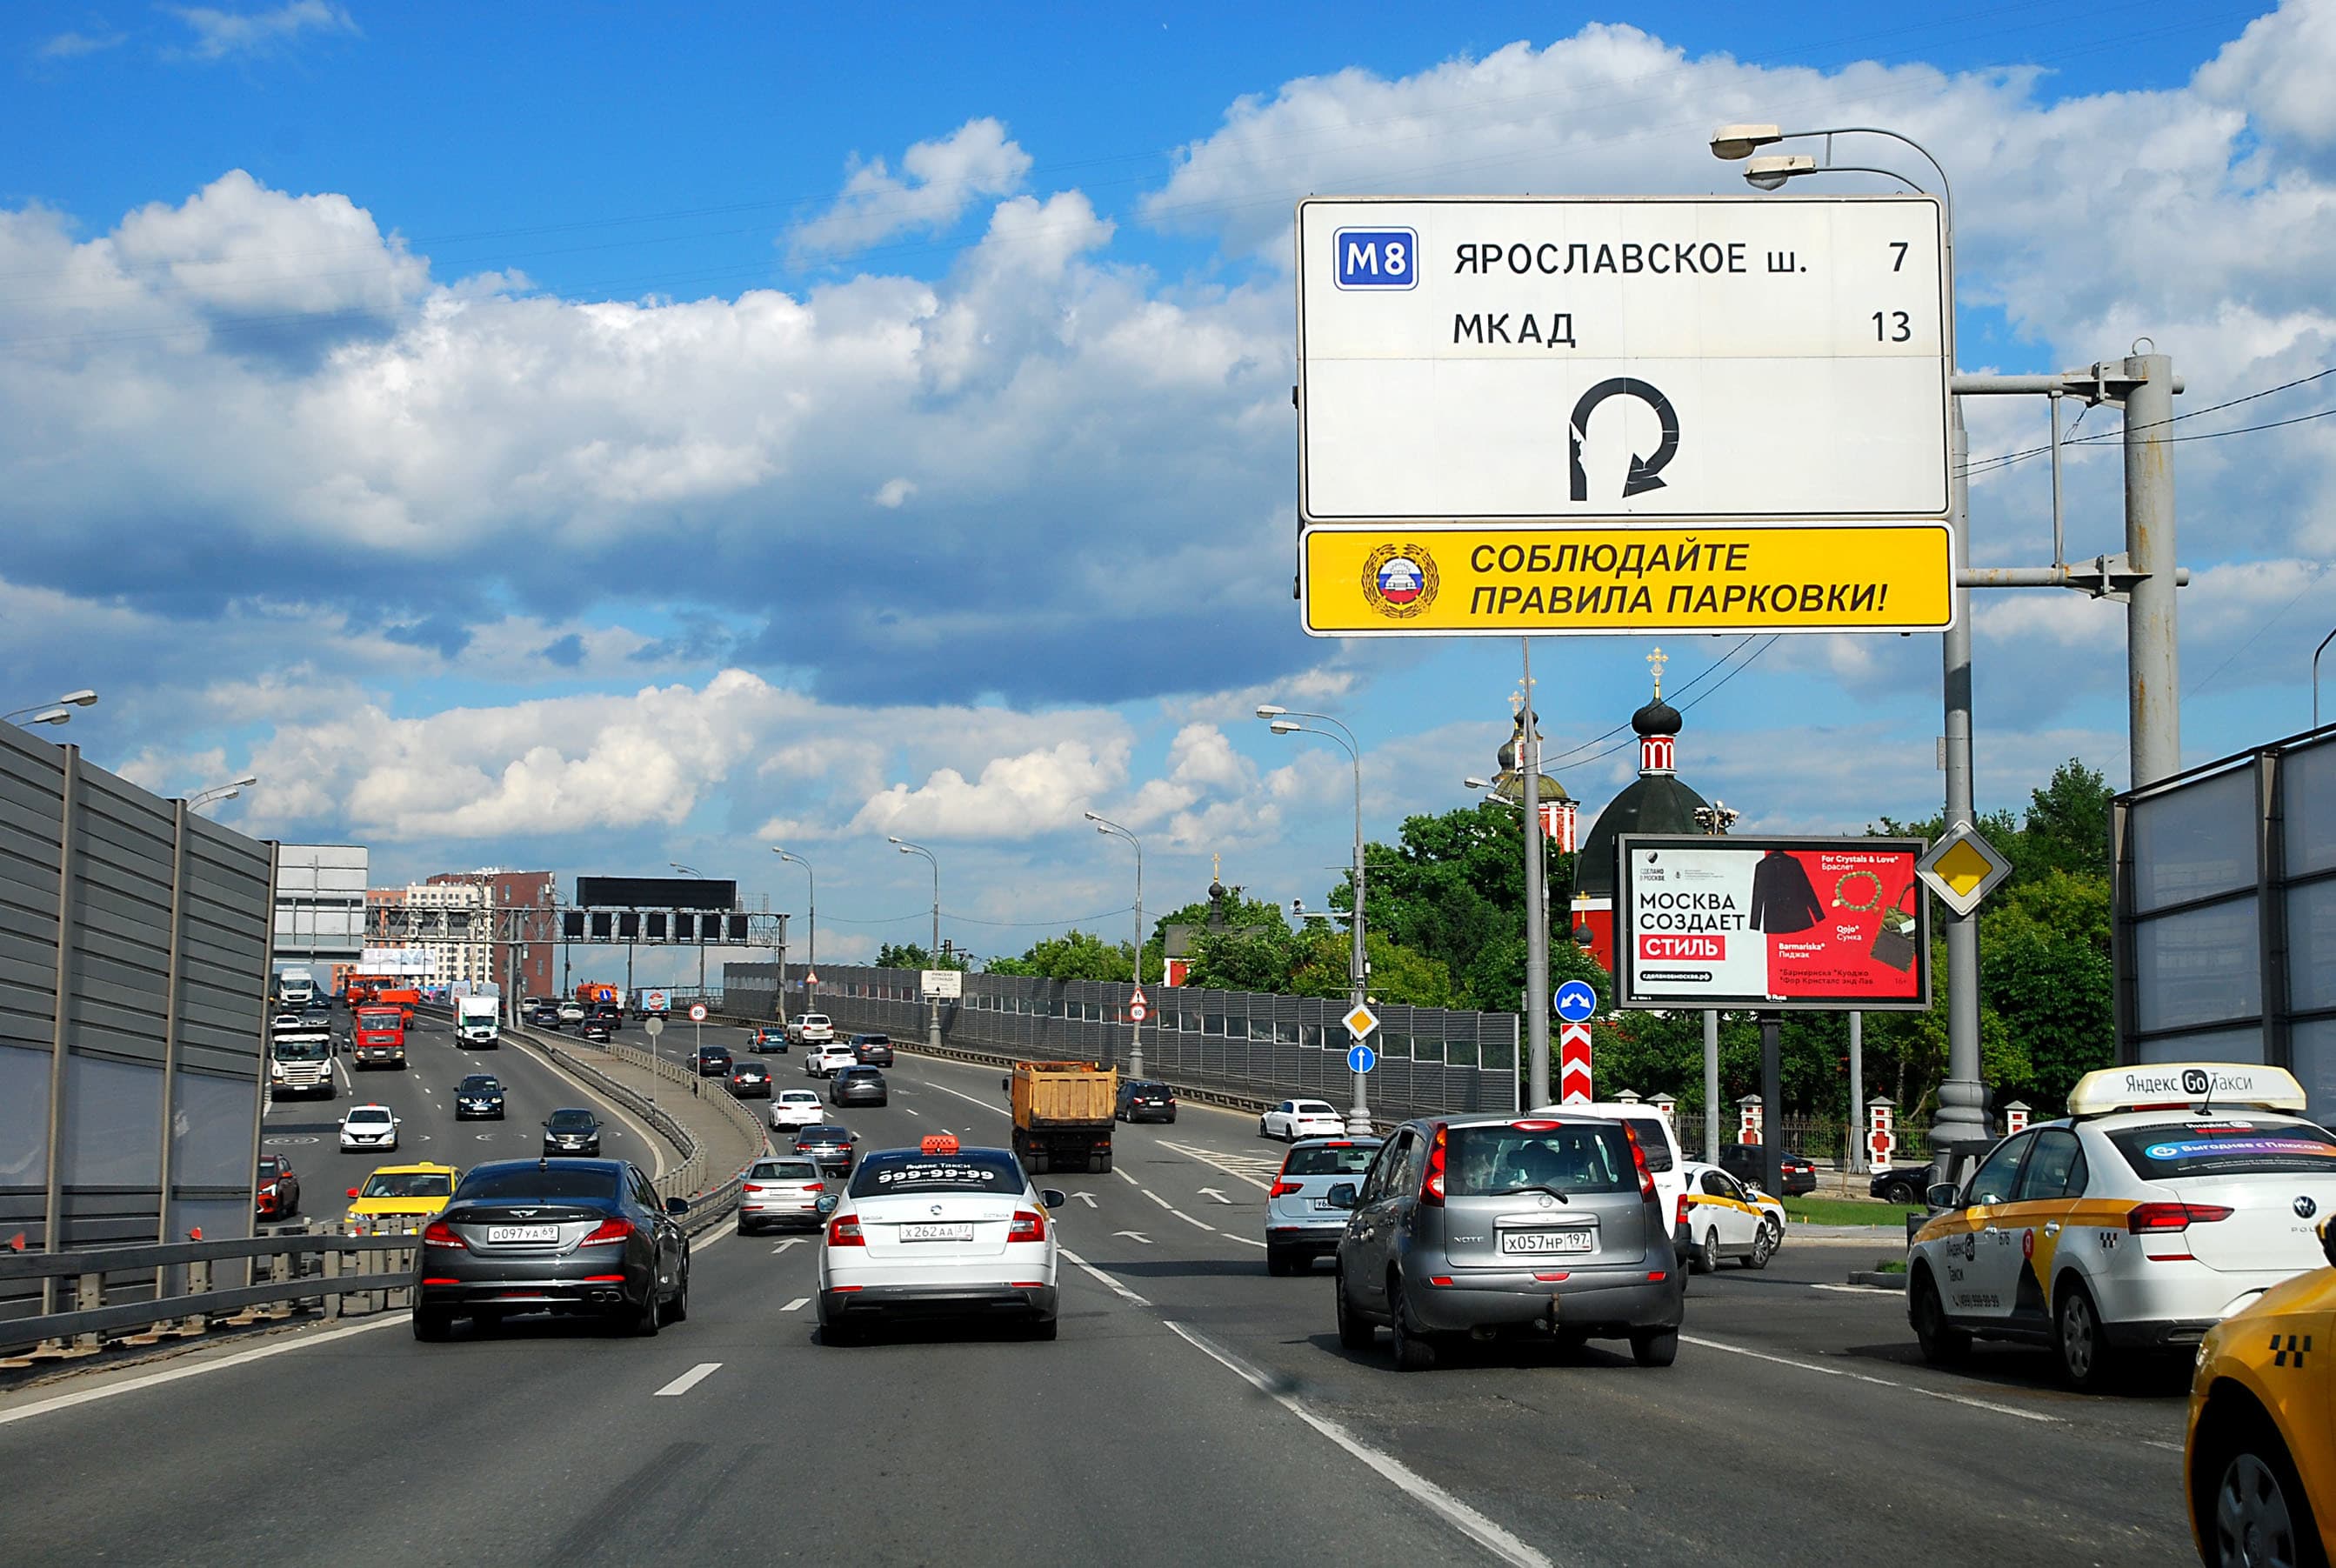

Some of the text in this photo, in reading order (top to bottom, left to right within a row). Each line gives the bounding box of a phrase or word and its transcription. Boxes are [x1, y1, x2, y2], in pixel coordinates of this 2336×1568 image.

[1453, 243, 1808, 275] ЯРОСЛАВСКОЕ ш.
[1889, 242, 1909, 272] 7
[1452, 313, 1576, 348] МКАД
[1871, 311, 1912, 342] 13
[1470, 536, 1750, 579] СОБЛЮДАЙТЕ
[1470, 583, 1888, 616] ПРАВИЛА ПАРКОВКИ!
[1836, 855, 1867, 864] Crystals
[1640, 892, 1736, 911] МОСКВА
[1640, 913, 1745, 933] СОЗДАЕТ
[1645, 937, 1719, 957] СТИЛЬ
[1836, 933, 1862, 943] Сумка
[1779, 951, 1810, 959] Пиджак
[2126, 1074, 2179, 1094] Яндекс
[2184, 1072, 2206, 1091] Go
[2210, 1072, 2253, 1091] Такси
[2180, 1141, 2254, 1153] Выгоднее
[2265, 1140, 2325, 1151] Плюсом
[878, 1169, 995, 1184] 999-99-99
